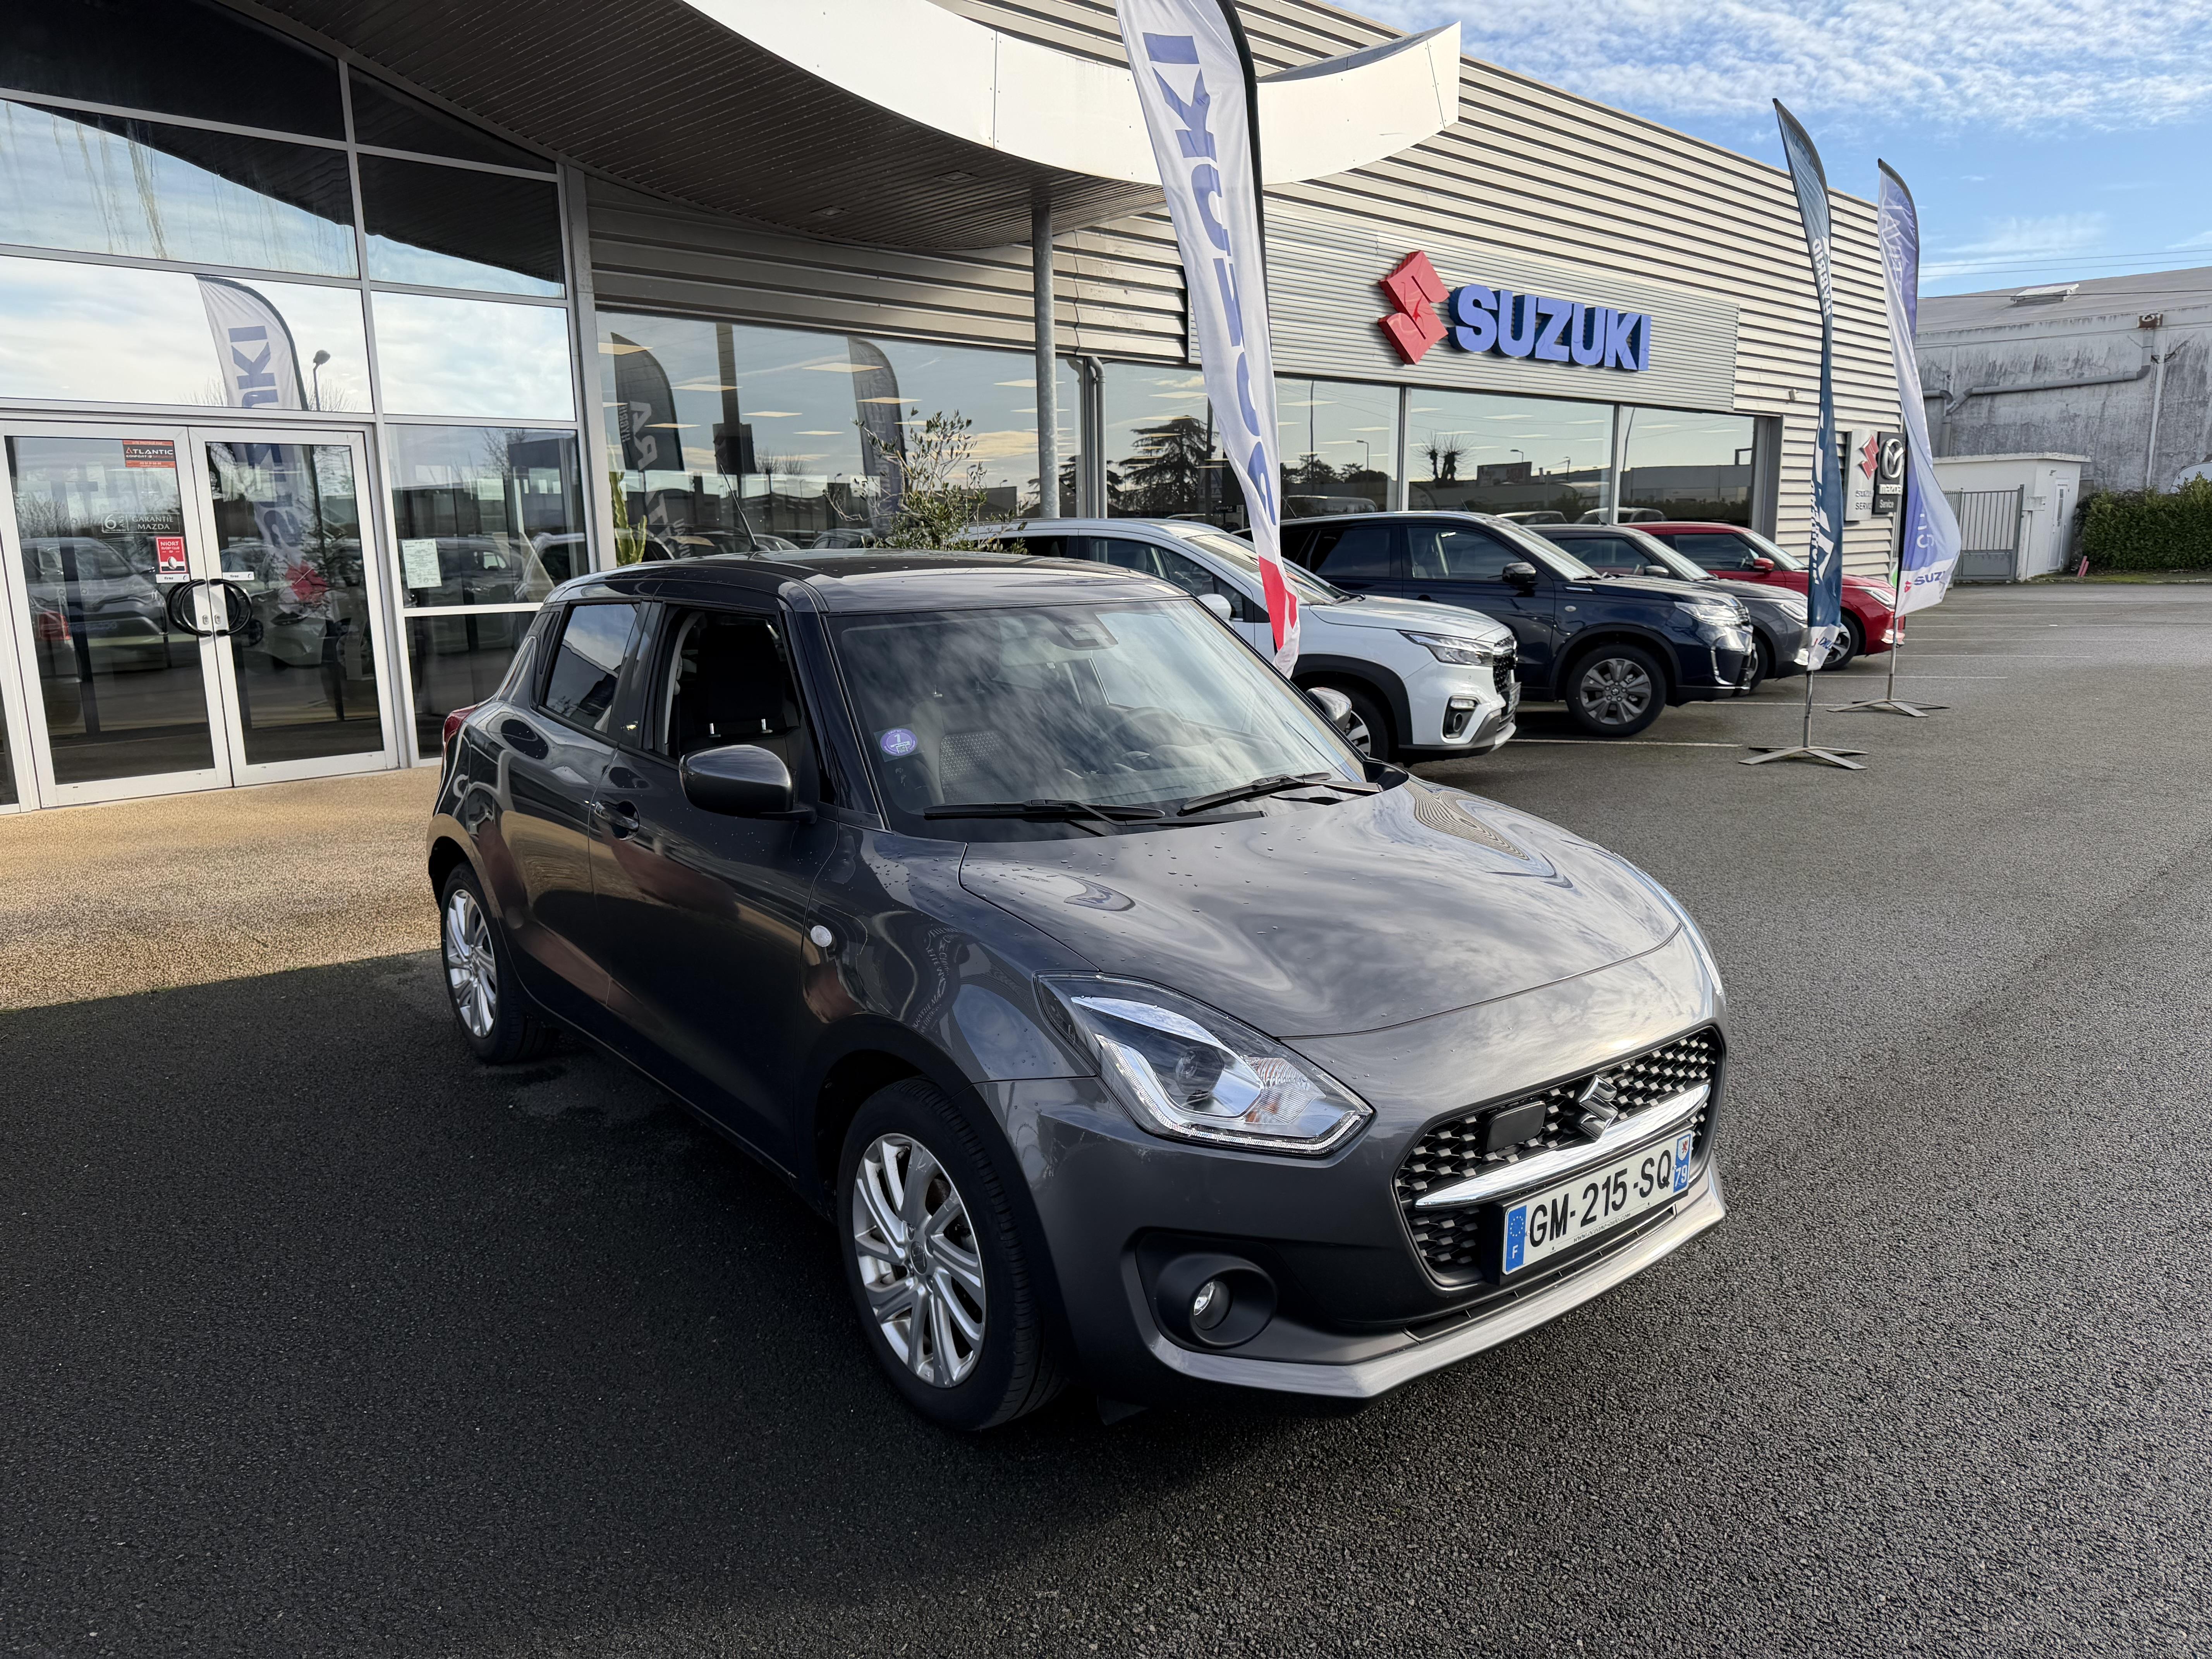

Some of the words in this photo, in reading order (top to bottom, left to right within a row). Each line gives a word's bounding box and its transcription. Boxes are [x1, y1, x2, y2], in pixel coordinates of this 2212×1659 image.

[1448, 283, 1652, 371] SUZUKI
[1879, 484, 1903, 495] mazda
[105, 514, 117, 529] 6
[1914, 570, 1946, 586] SUZ
[894, 733, 902, 744] 1
[1529, 1149, 1672, 1248] GM-215-SQ
[1674, 1164, 1688, 1187] 79
[1512, 1244, 1519, 1259] F
